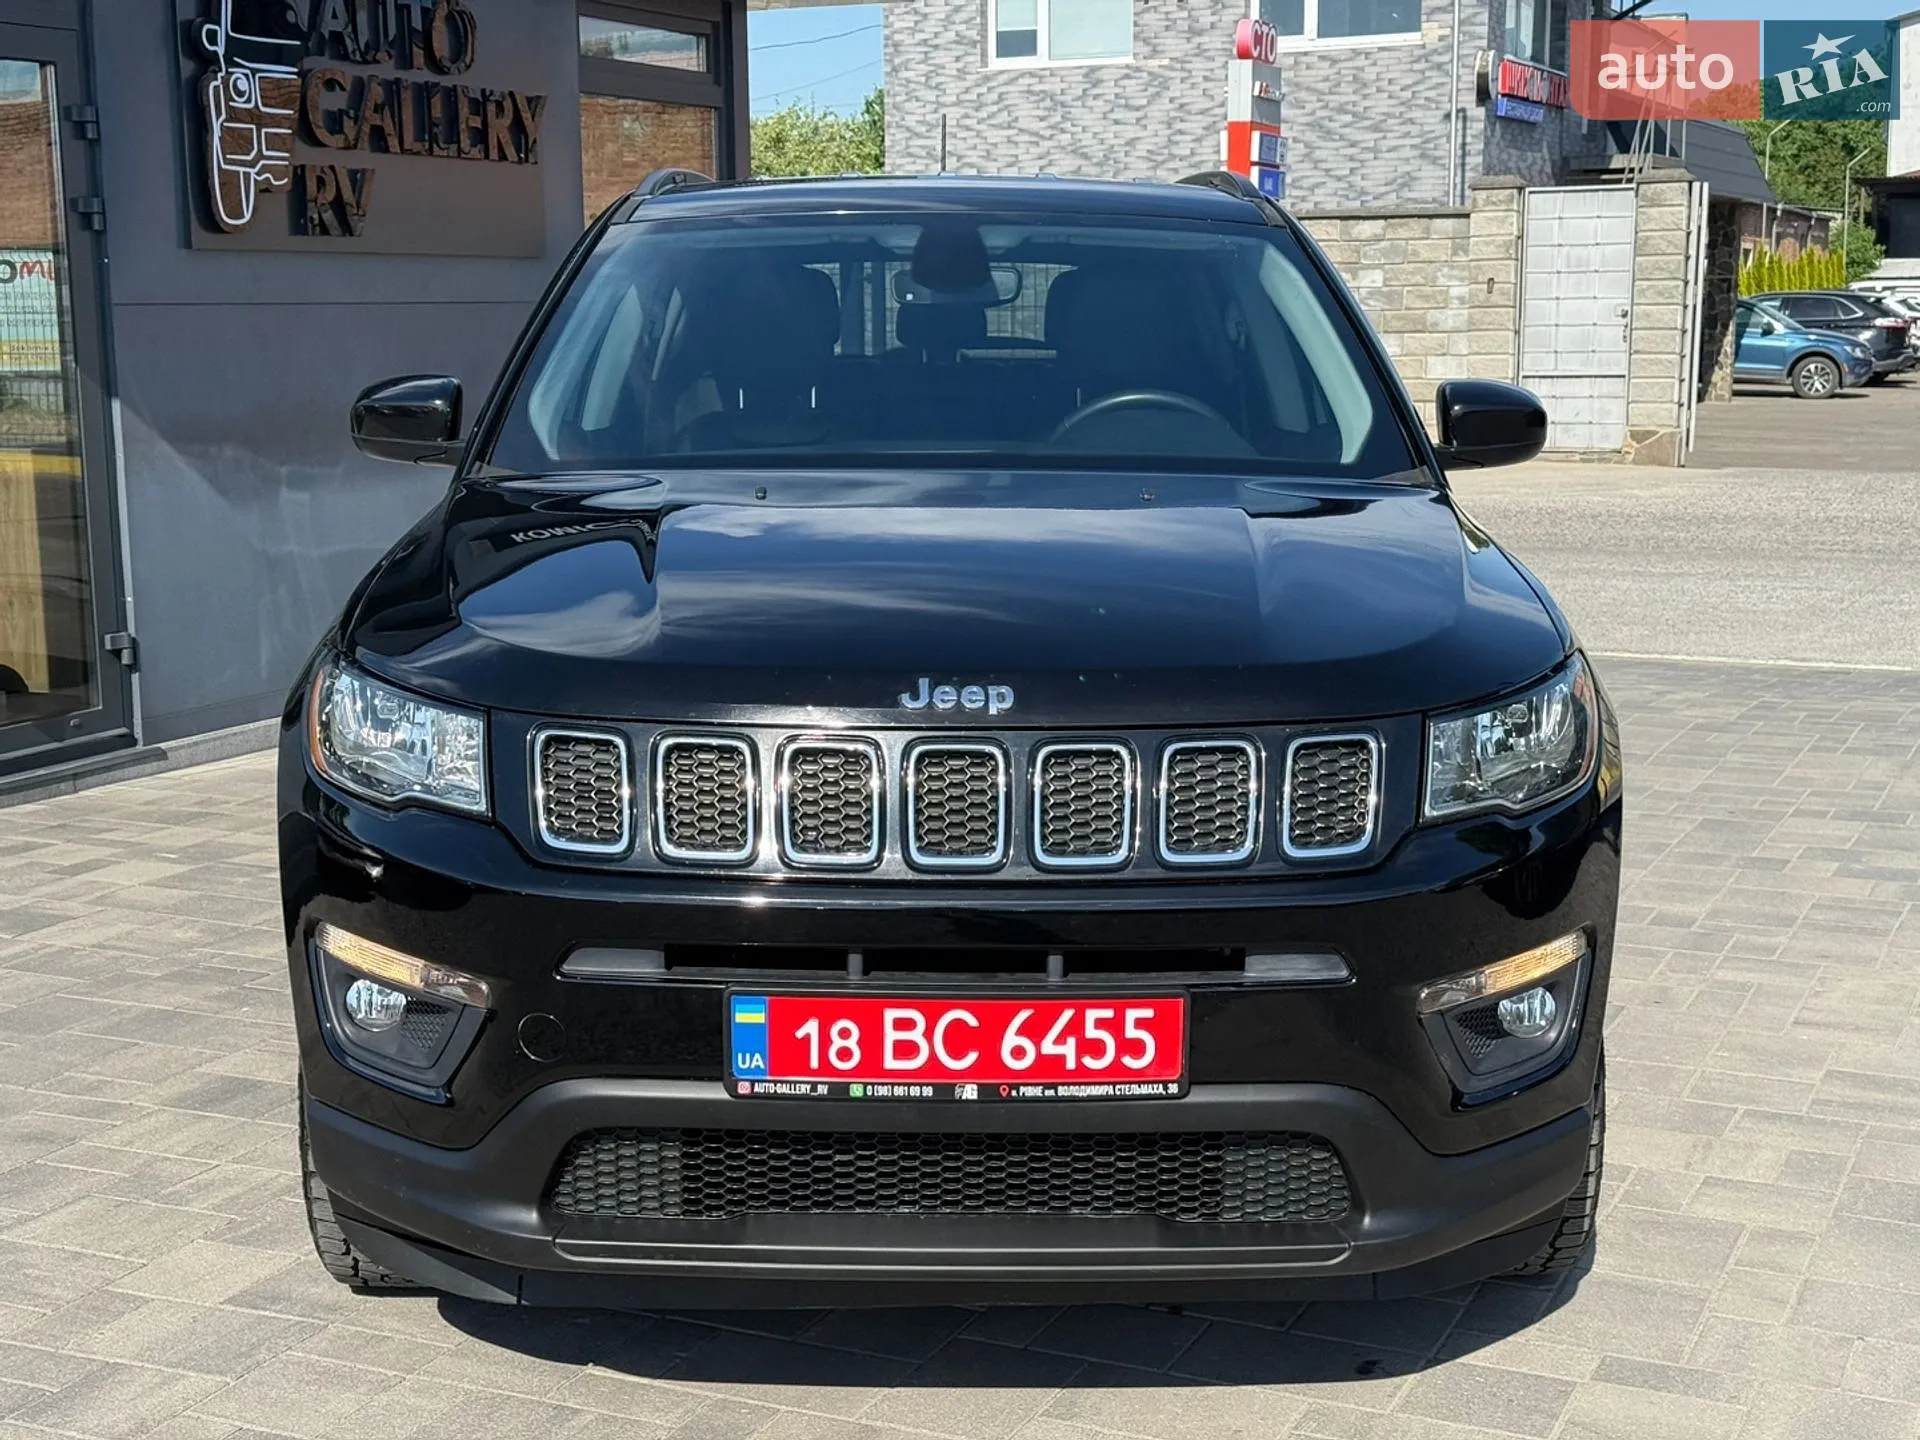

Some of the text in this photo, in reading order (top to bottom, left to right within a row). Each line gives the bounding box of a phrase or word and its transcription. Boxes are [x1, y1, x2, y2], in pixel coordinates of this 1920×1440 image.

[309, 0, 478, 75] AUTO
[305, 67, 548, 164] GALLERY
[301, 164, 376, 237] RV
[899, 677, 1015, 715] Jeep
[737, 1051, 765, 1070] UA
[794, 1007, 1157, 1071] 18 BC 6455
[1057, 1084, 1114, 1098] ВОЛОДИМИРА
